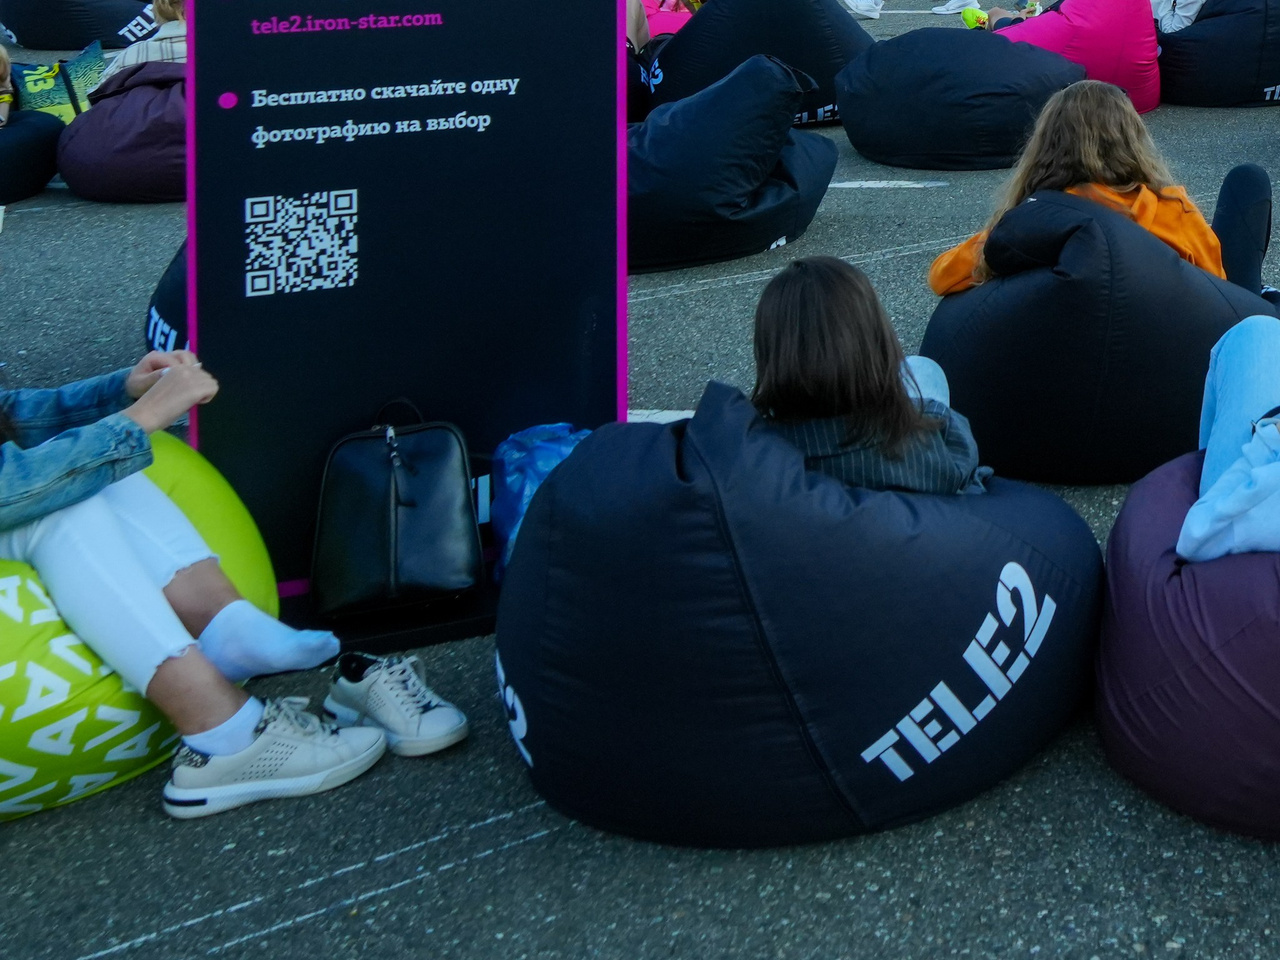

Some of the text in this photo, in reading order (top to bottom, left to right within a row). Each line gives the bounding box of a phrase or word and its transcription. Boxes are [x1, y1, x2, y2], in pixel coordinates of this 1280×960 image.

[251, 11, 443, 35] tele2.iron-star.com
[251, 77, 520, 108] Бесплатно скачайте одну
[251, 113, 492, 148] фотографию на выбор
[860, 561, 1057, 782] TELE2
